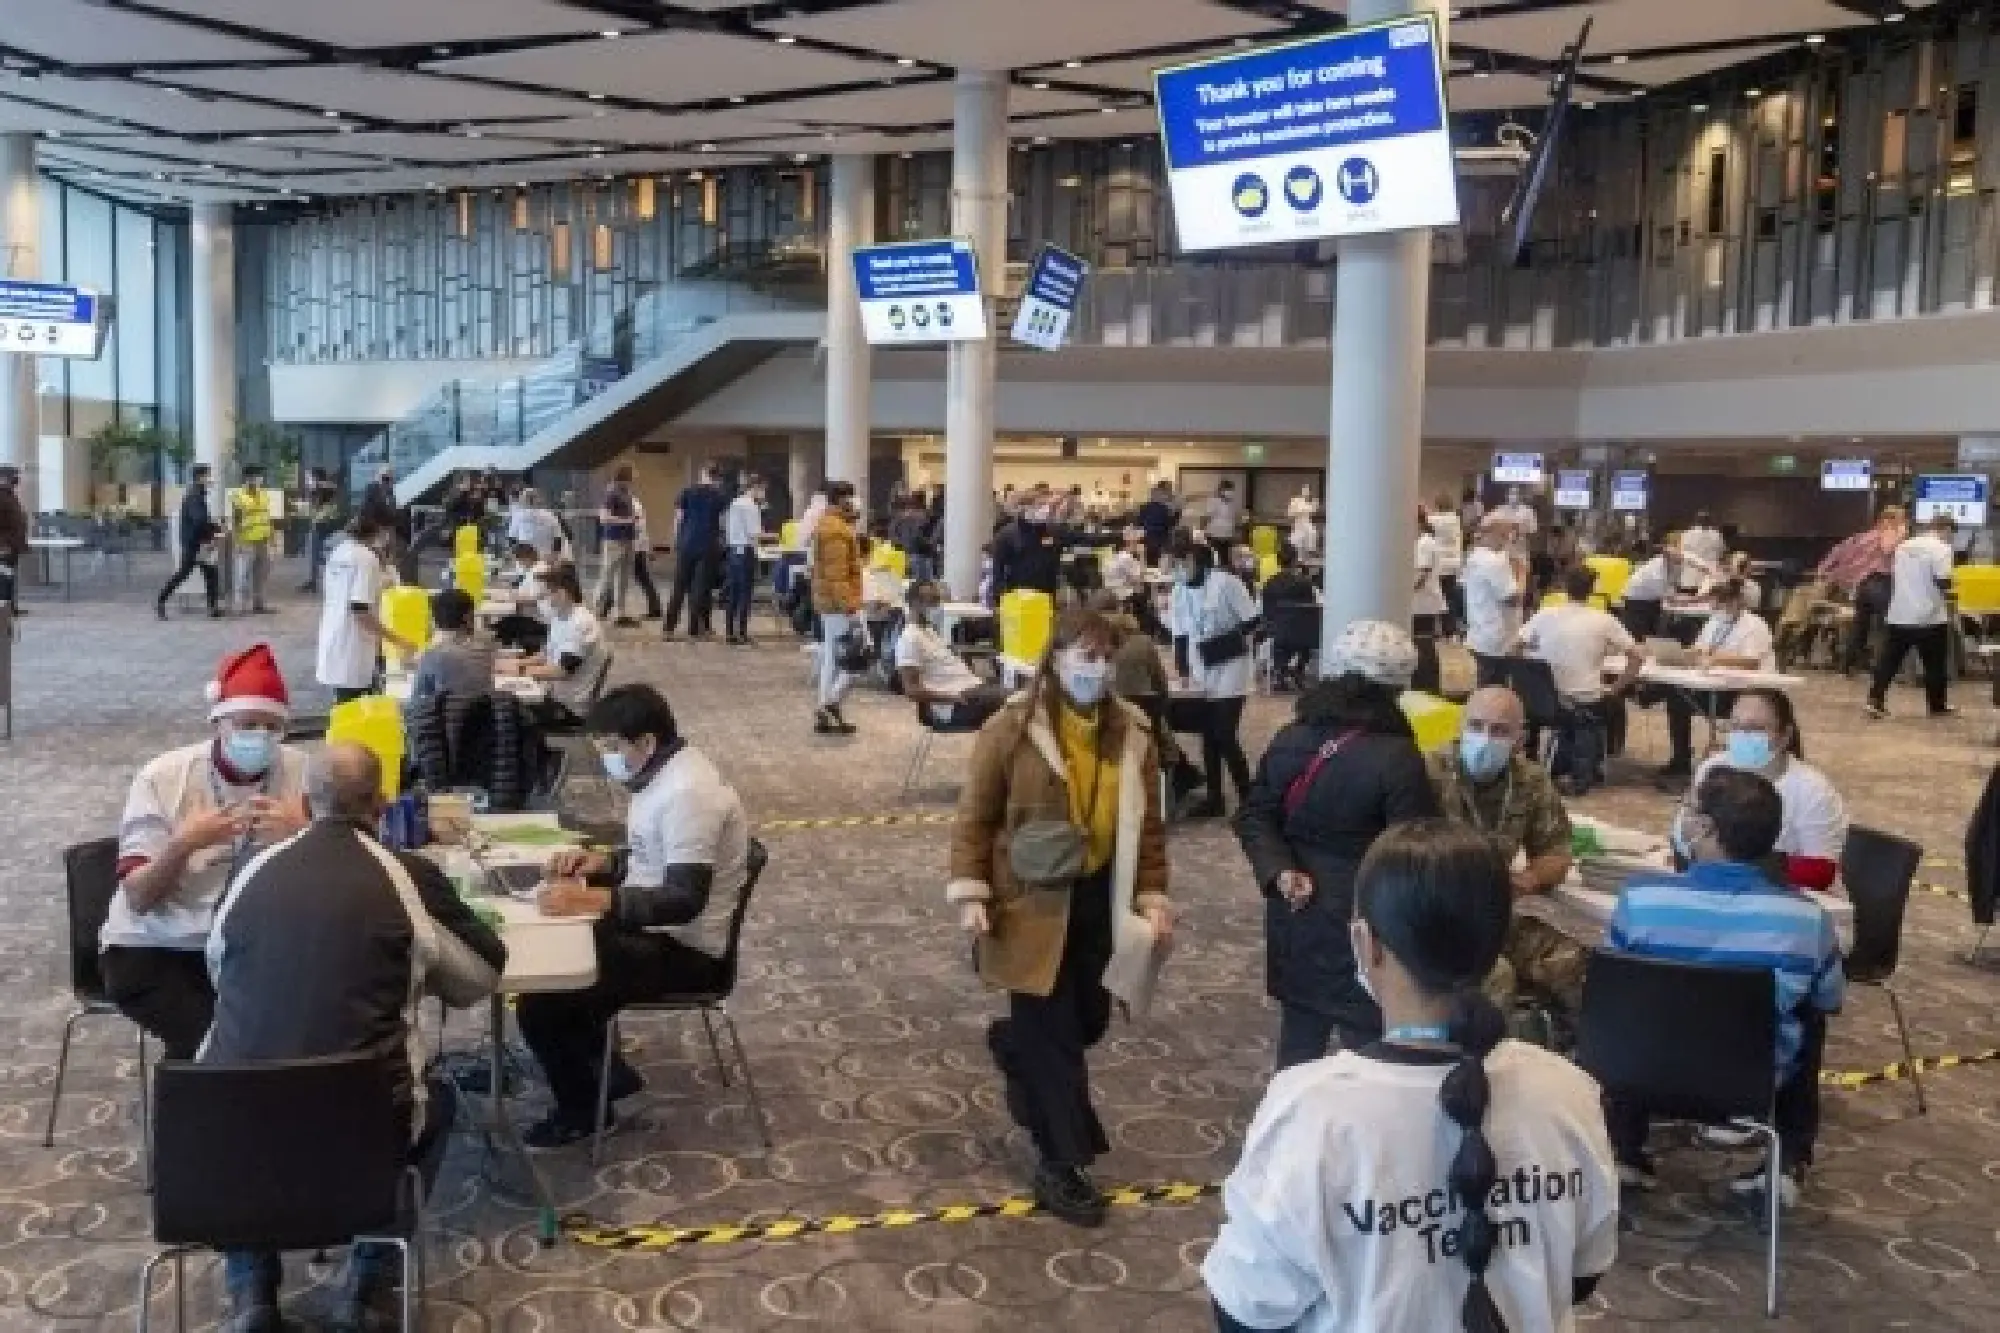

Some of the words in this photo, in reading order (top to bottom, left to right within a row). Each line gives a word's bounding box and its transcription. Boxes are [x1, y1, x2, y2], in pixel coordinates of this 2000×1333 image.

[1196, 76, 1249, 105] Thank
[1253, 75, 1284, 98] you
[1287, 67, 1312, 88] for
[1316, 56, 1386, 82] coming
[1342, 1165, 1582, 1236] Vacciation
[1417, 1216, 1531, 1264] Tem
